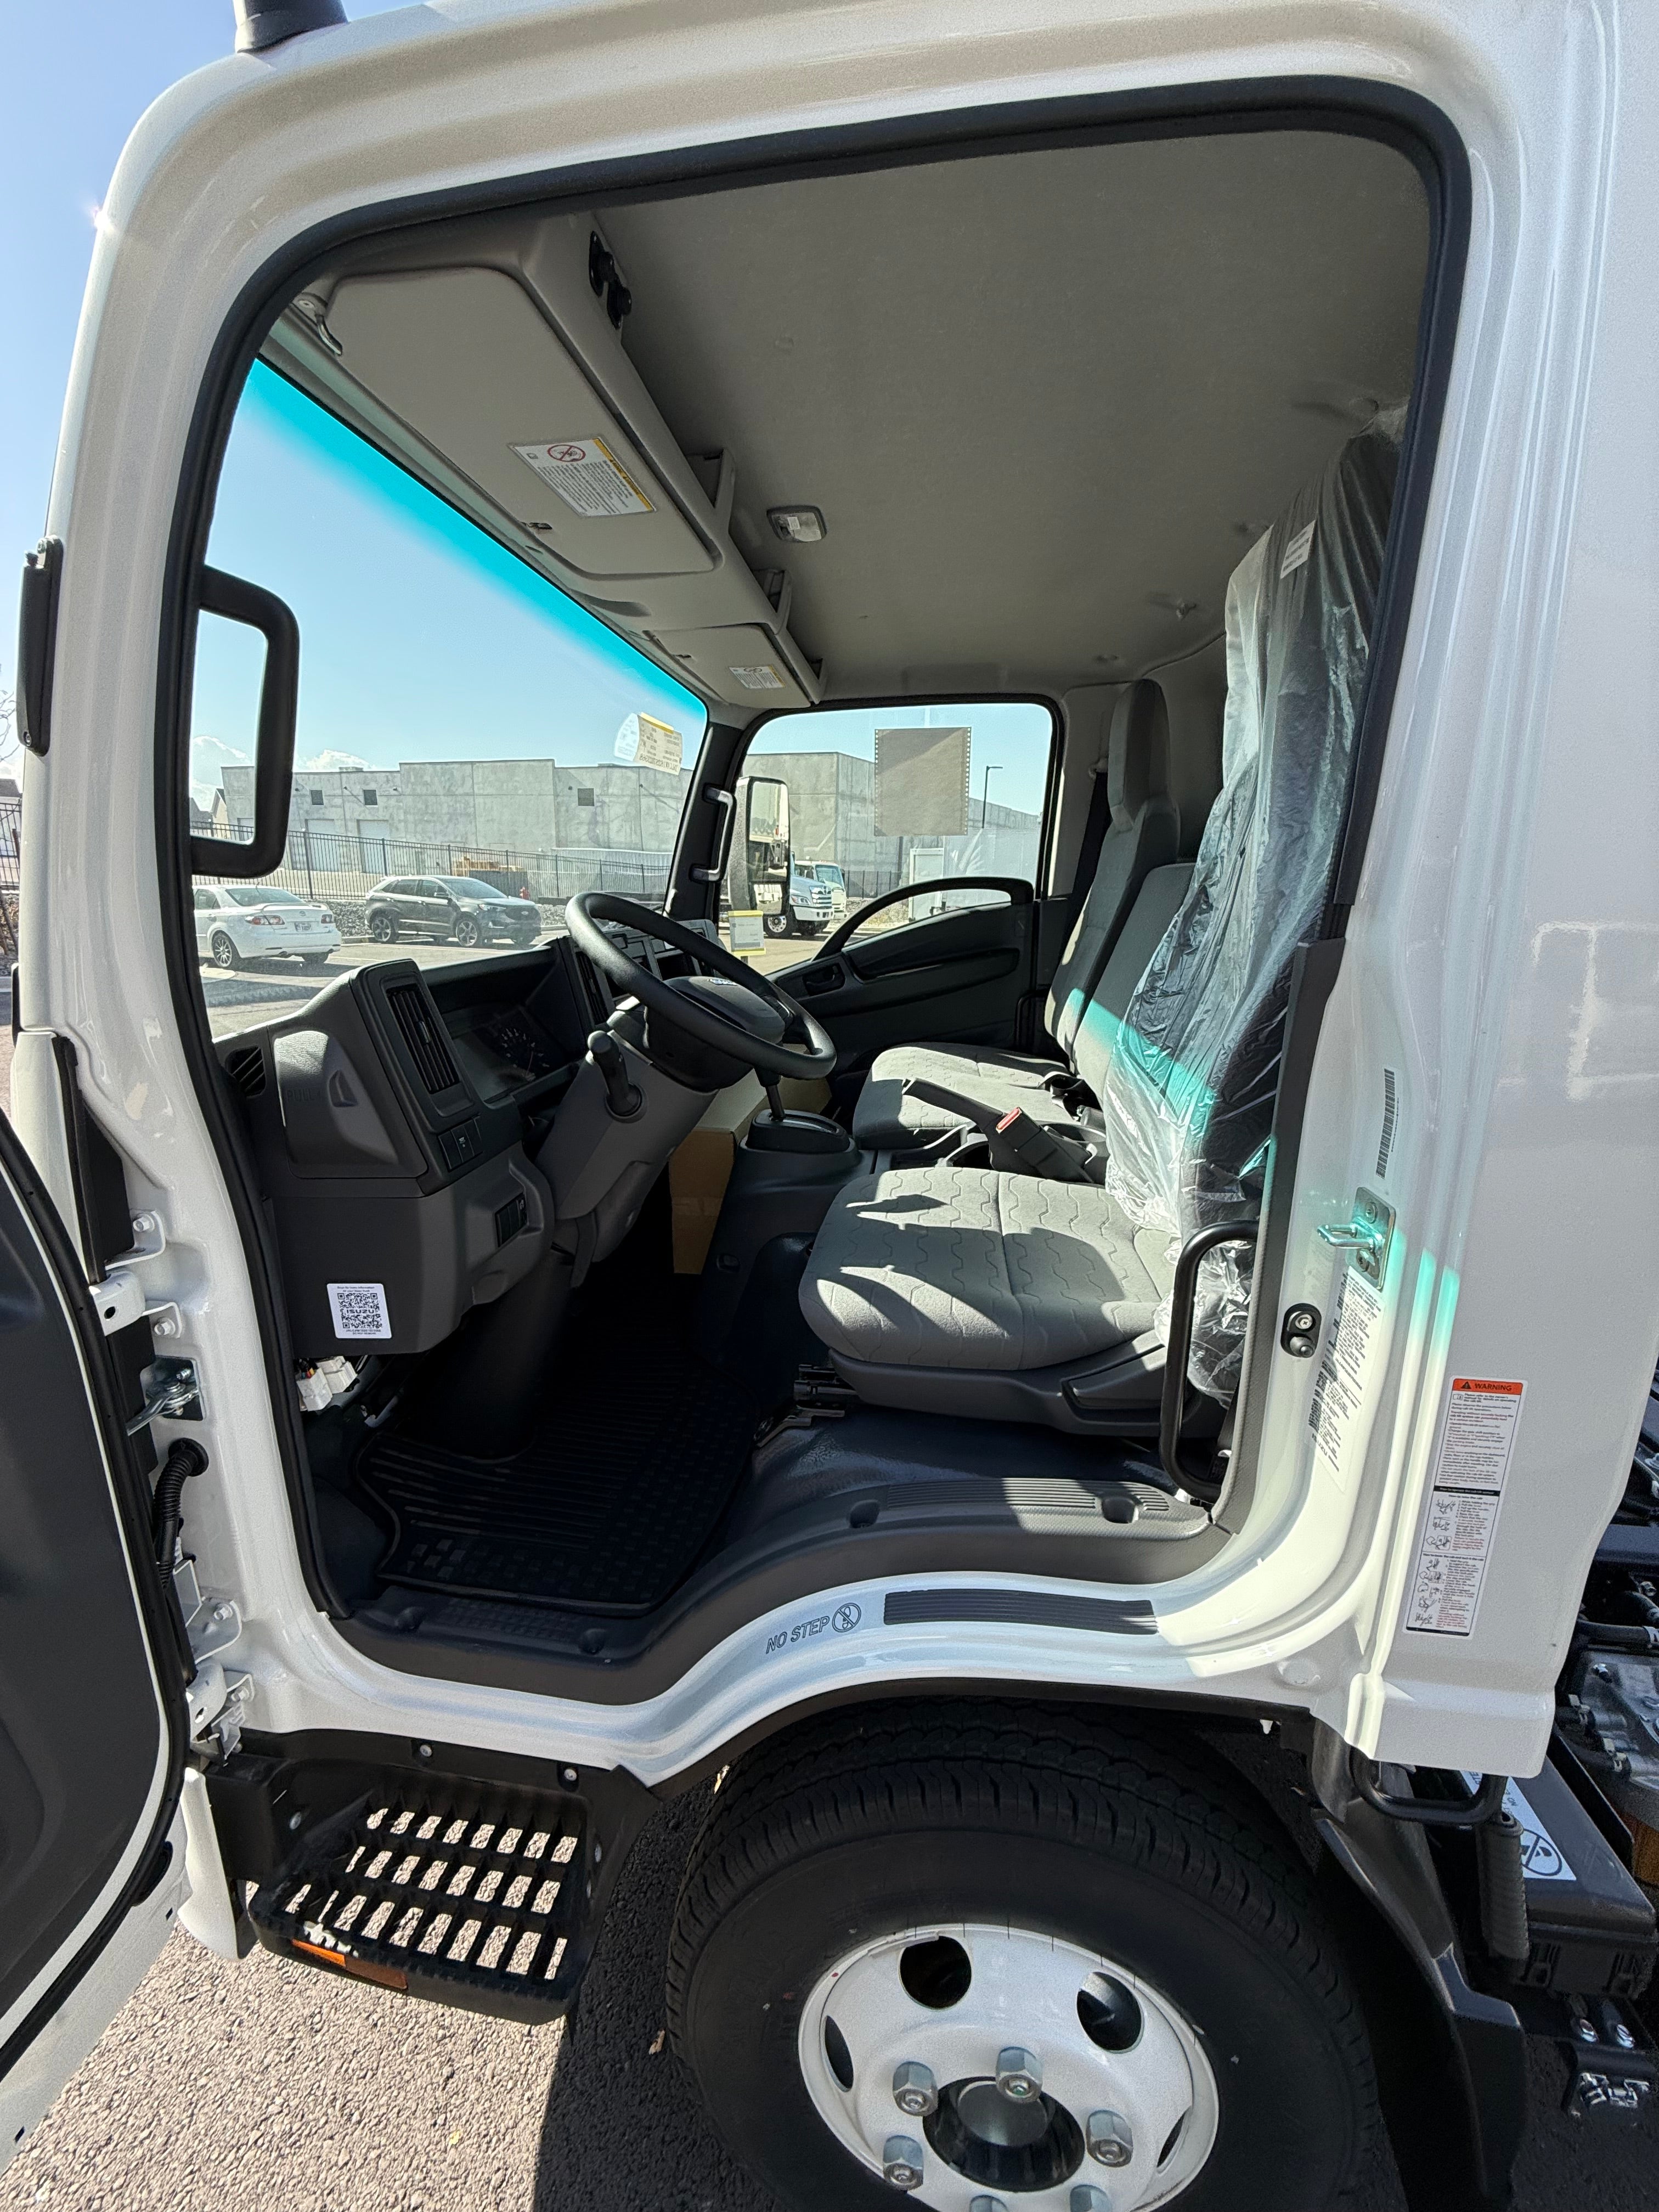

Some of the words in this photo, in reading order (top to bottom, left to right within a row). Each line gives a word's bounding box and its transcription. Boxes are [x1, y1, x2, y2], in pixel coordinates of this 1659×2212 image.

[1474, 1383, 1512, 1391] WARNING
[766, 1631, 787, 1655] NO
[791, 1616, 830, 1643] STEP
[1470, 1772, 1481, 1785] STE
